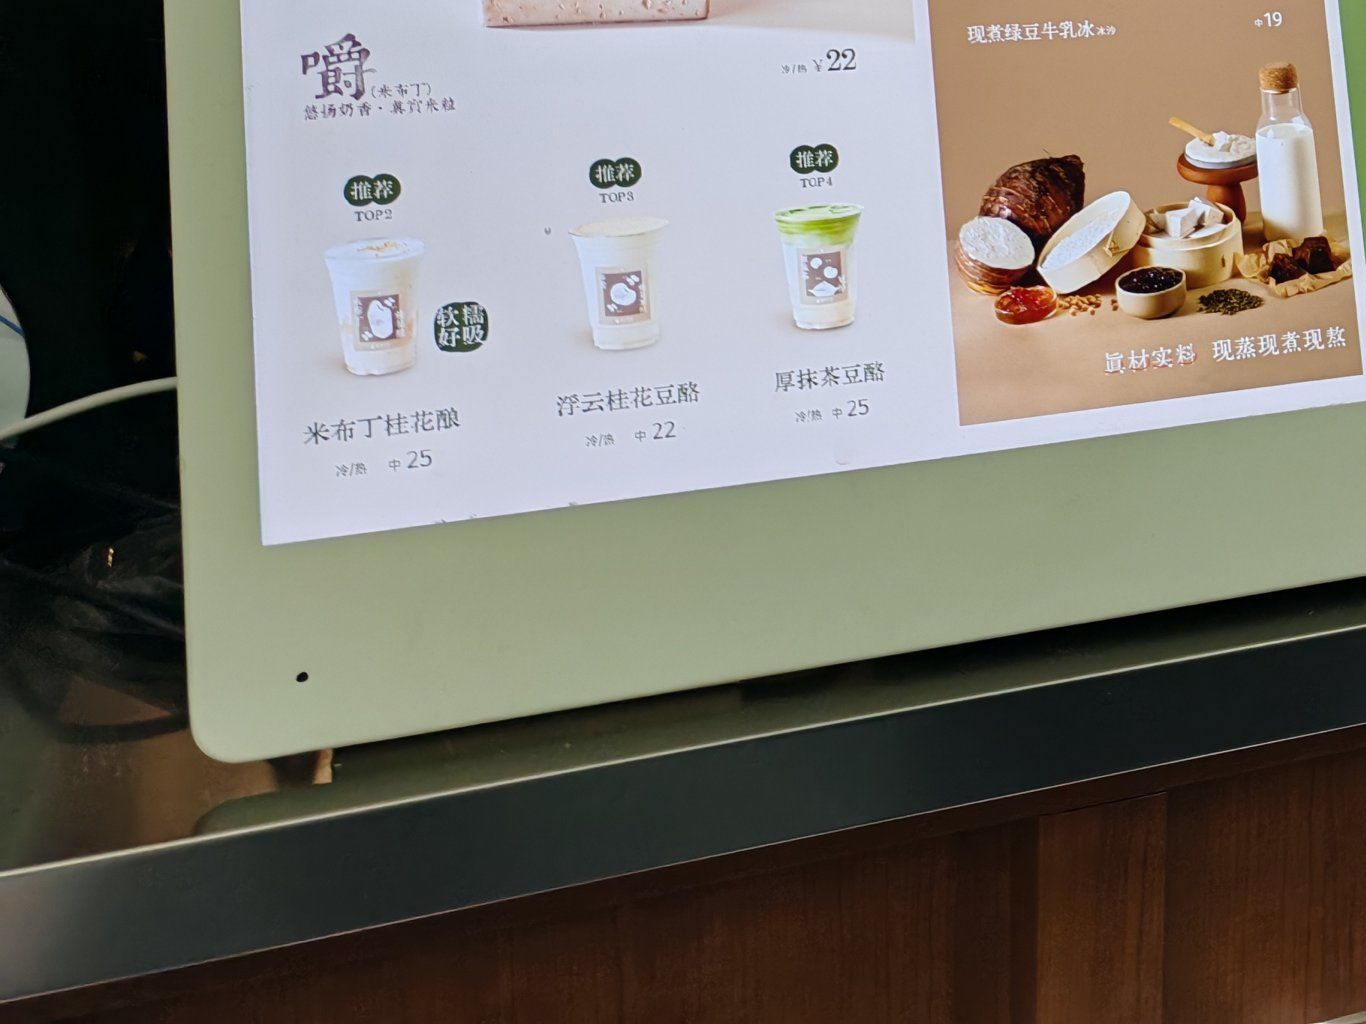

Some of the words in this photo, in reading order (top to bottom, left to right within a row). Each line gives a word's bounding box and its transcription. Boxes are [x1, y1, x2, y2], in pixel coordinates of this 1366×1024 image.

[967, 20, 1095, 44] 现煮绿豆牛乳冰
[795, 147, 835, 168] 推荐
[595, 162, 635, 184] 推荐
[800, 177, 834, 188] TOP4
[350, 179, 394, 202] 推荐
[600, 191, 634, 203] TOP3
[355, 208, 393, 222] TOP2
[1212, 326, 1347, 363] 现蒸现煮现熬
[775, 360, 885, 393] 厚抹茶豆酪
[557, 380, 701, 417] 浮云桂花豆酪
[303, 407, 462, 445] 米布丁桂花酿
